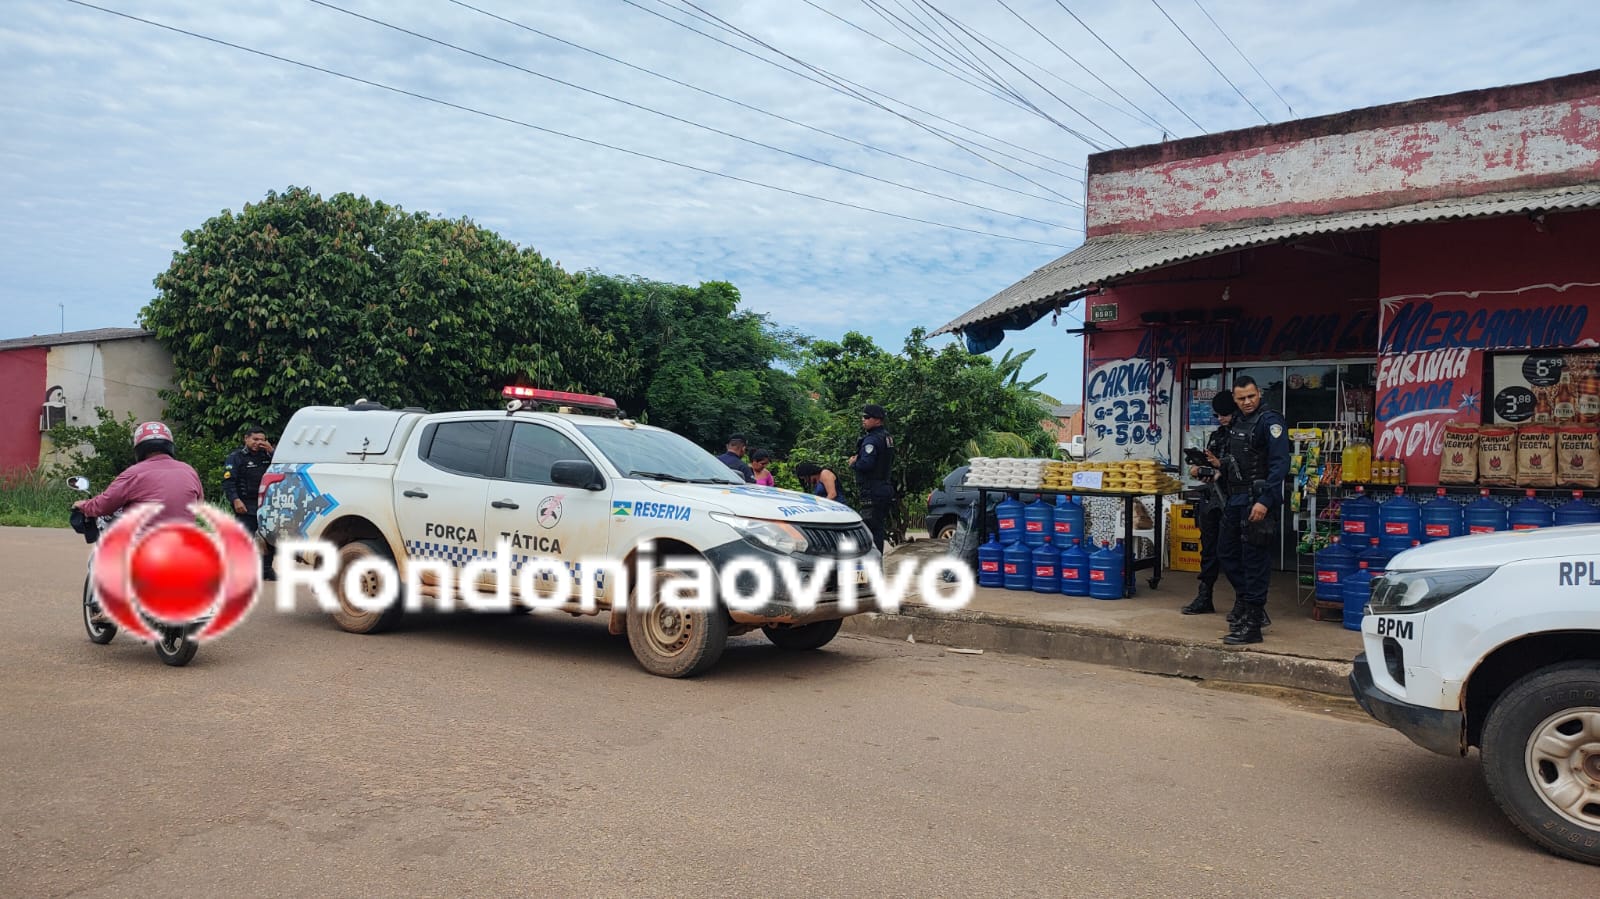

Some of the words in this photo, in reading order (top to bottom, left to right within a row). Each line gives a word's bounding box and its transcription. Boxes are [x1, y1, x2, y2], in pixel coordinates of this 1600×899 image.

[1380, 302, 1588, 354] MERCADINHO
[1376, 348, 1470, 391] FARINHA
[1520, 433, 1550, 441] CARVÃO
[1561, 433, 1593, 441] CARVÃO
[1443, 440, 1474, 449] VEGETAL
[1479, 443, 1511, 451] VEGETAL
[1519, 441, 1552, 449] VEGETAL
[1560, 441, 1595, 450] VEGETAL
[633, 501, 692, 522] RESERVA
[425, 522, 478, 545] FORÇA
[501, 530, 562, 554] TÁTICA
[1377, 617, 1414, 640] BPM
